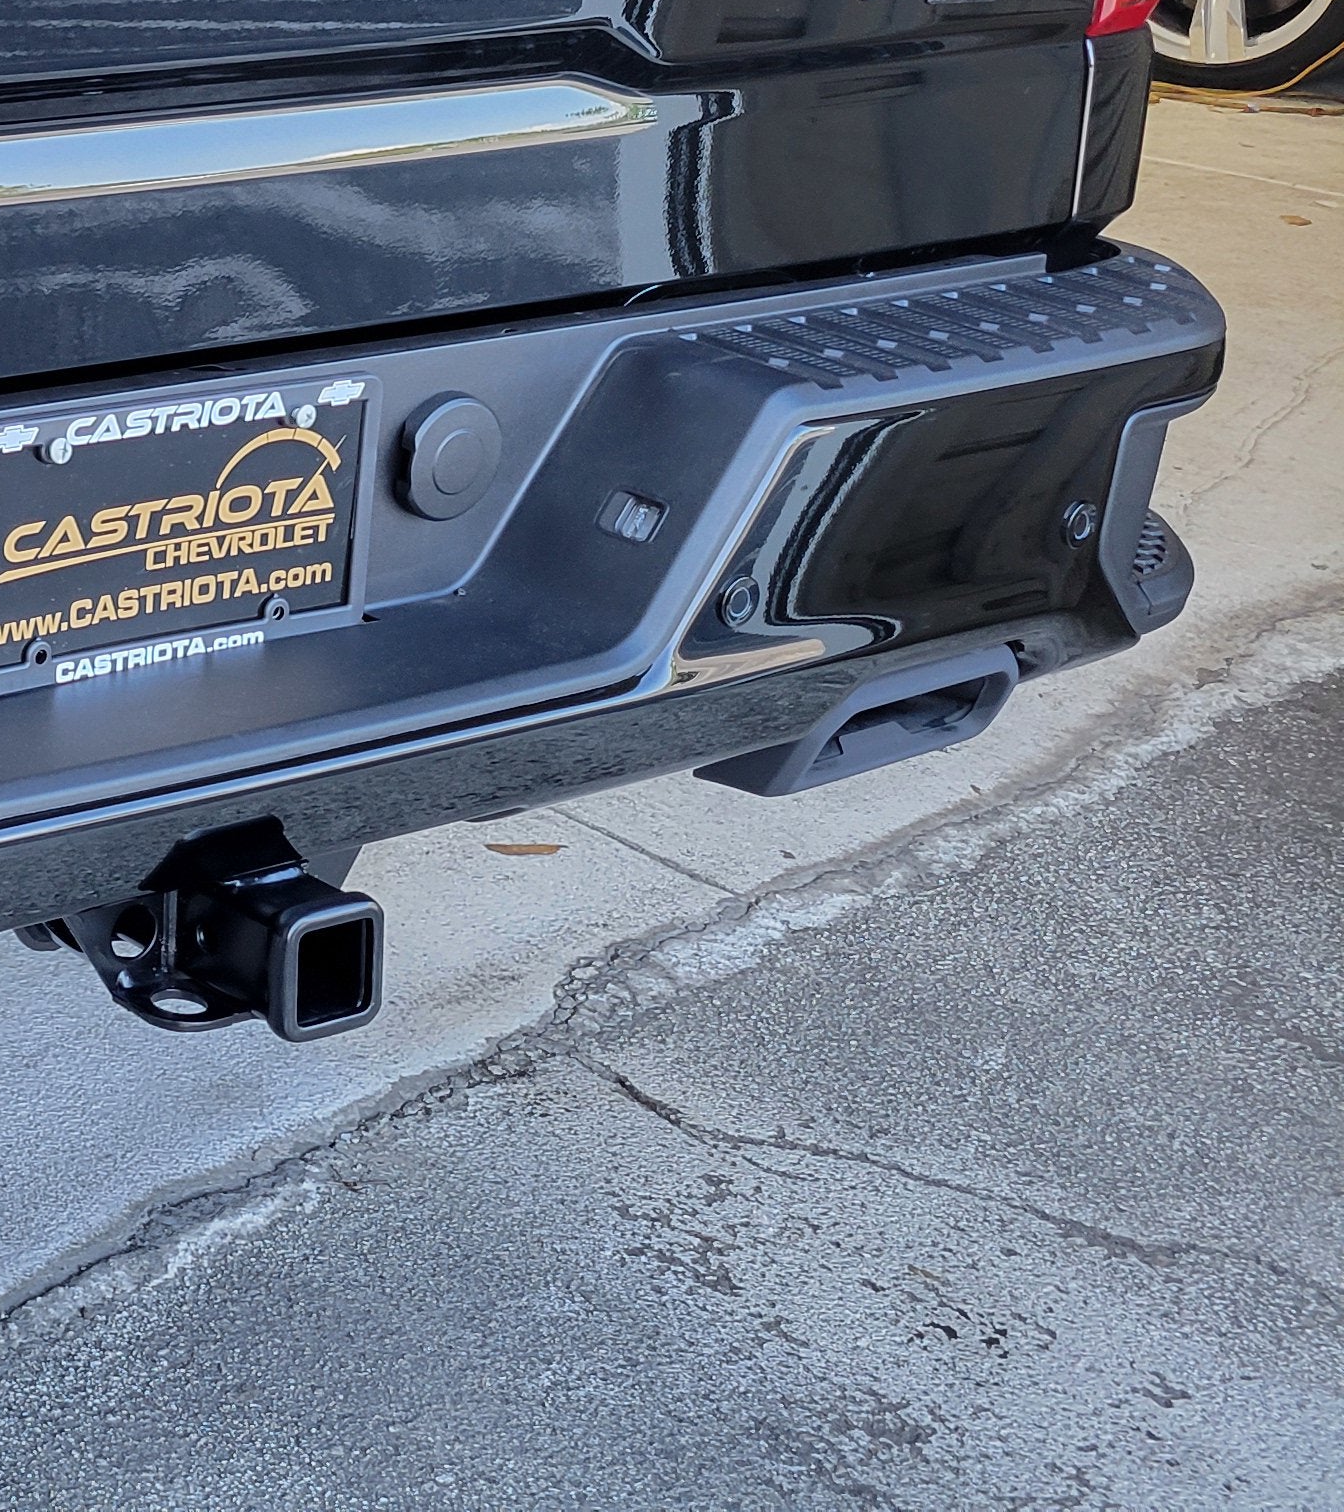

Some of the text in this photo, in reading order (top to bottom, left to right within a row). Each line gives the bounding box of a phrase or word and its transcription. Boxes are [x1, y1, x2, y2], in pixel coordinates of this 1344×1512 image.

[65, 392, 286, 445] CASTRIOTA
[3, 475, 335, 563] CASTRIOTA
[145, 519, 335, 571] CHEVROLET
[55, 630, 264, 684] CASTRIOTA.com
